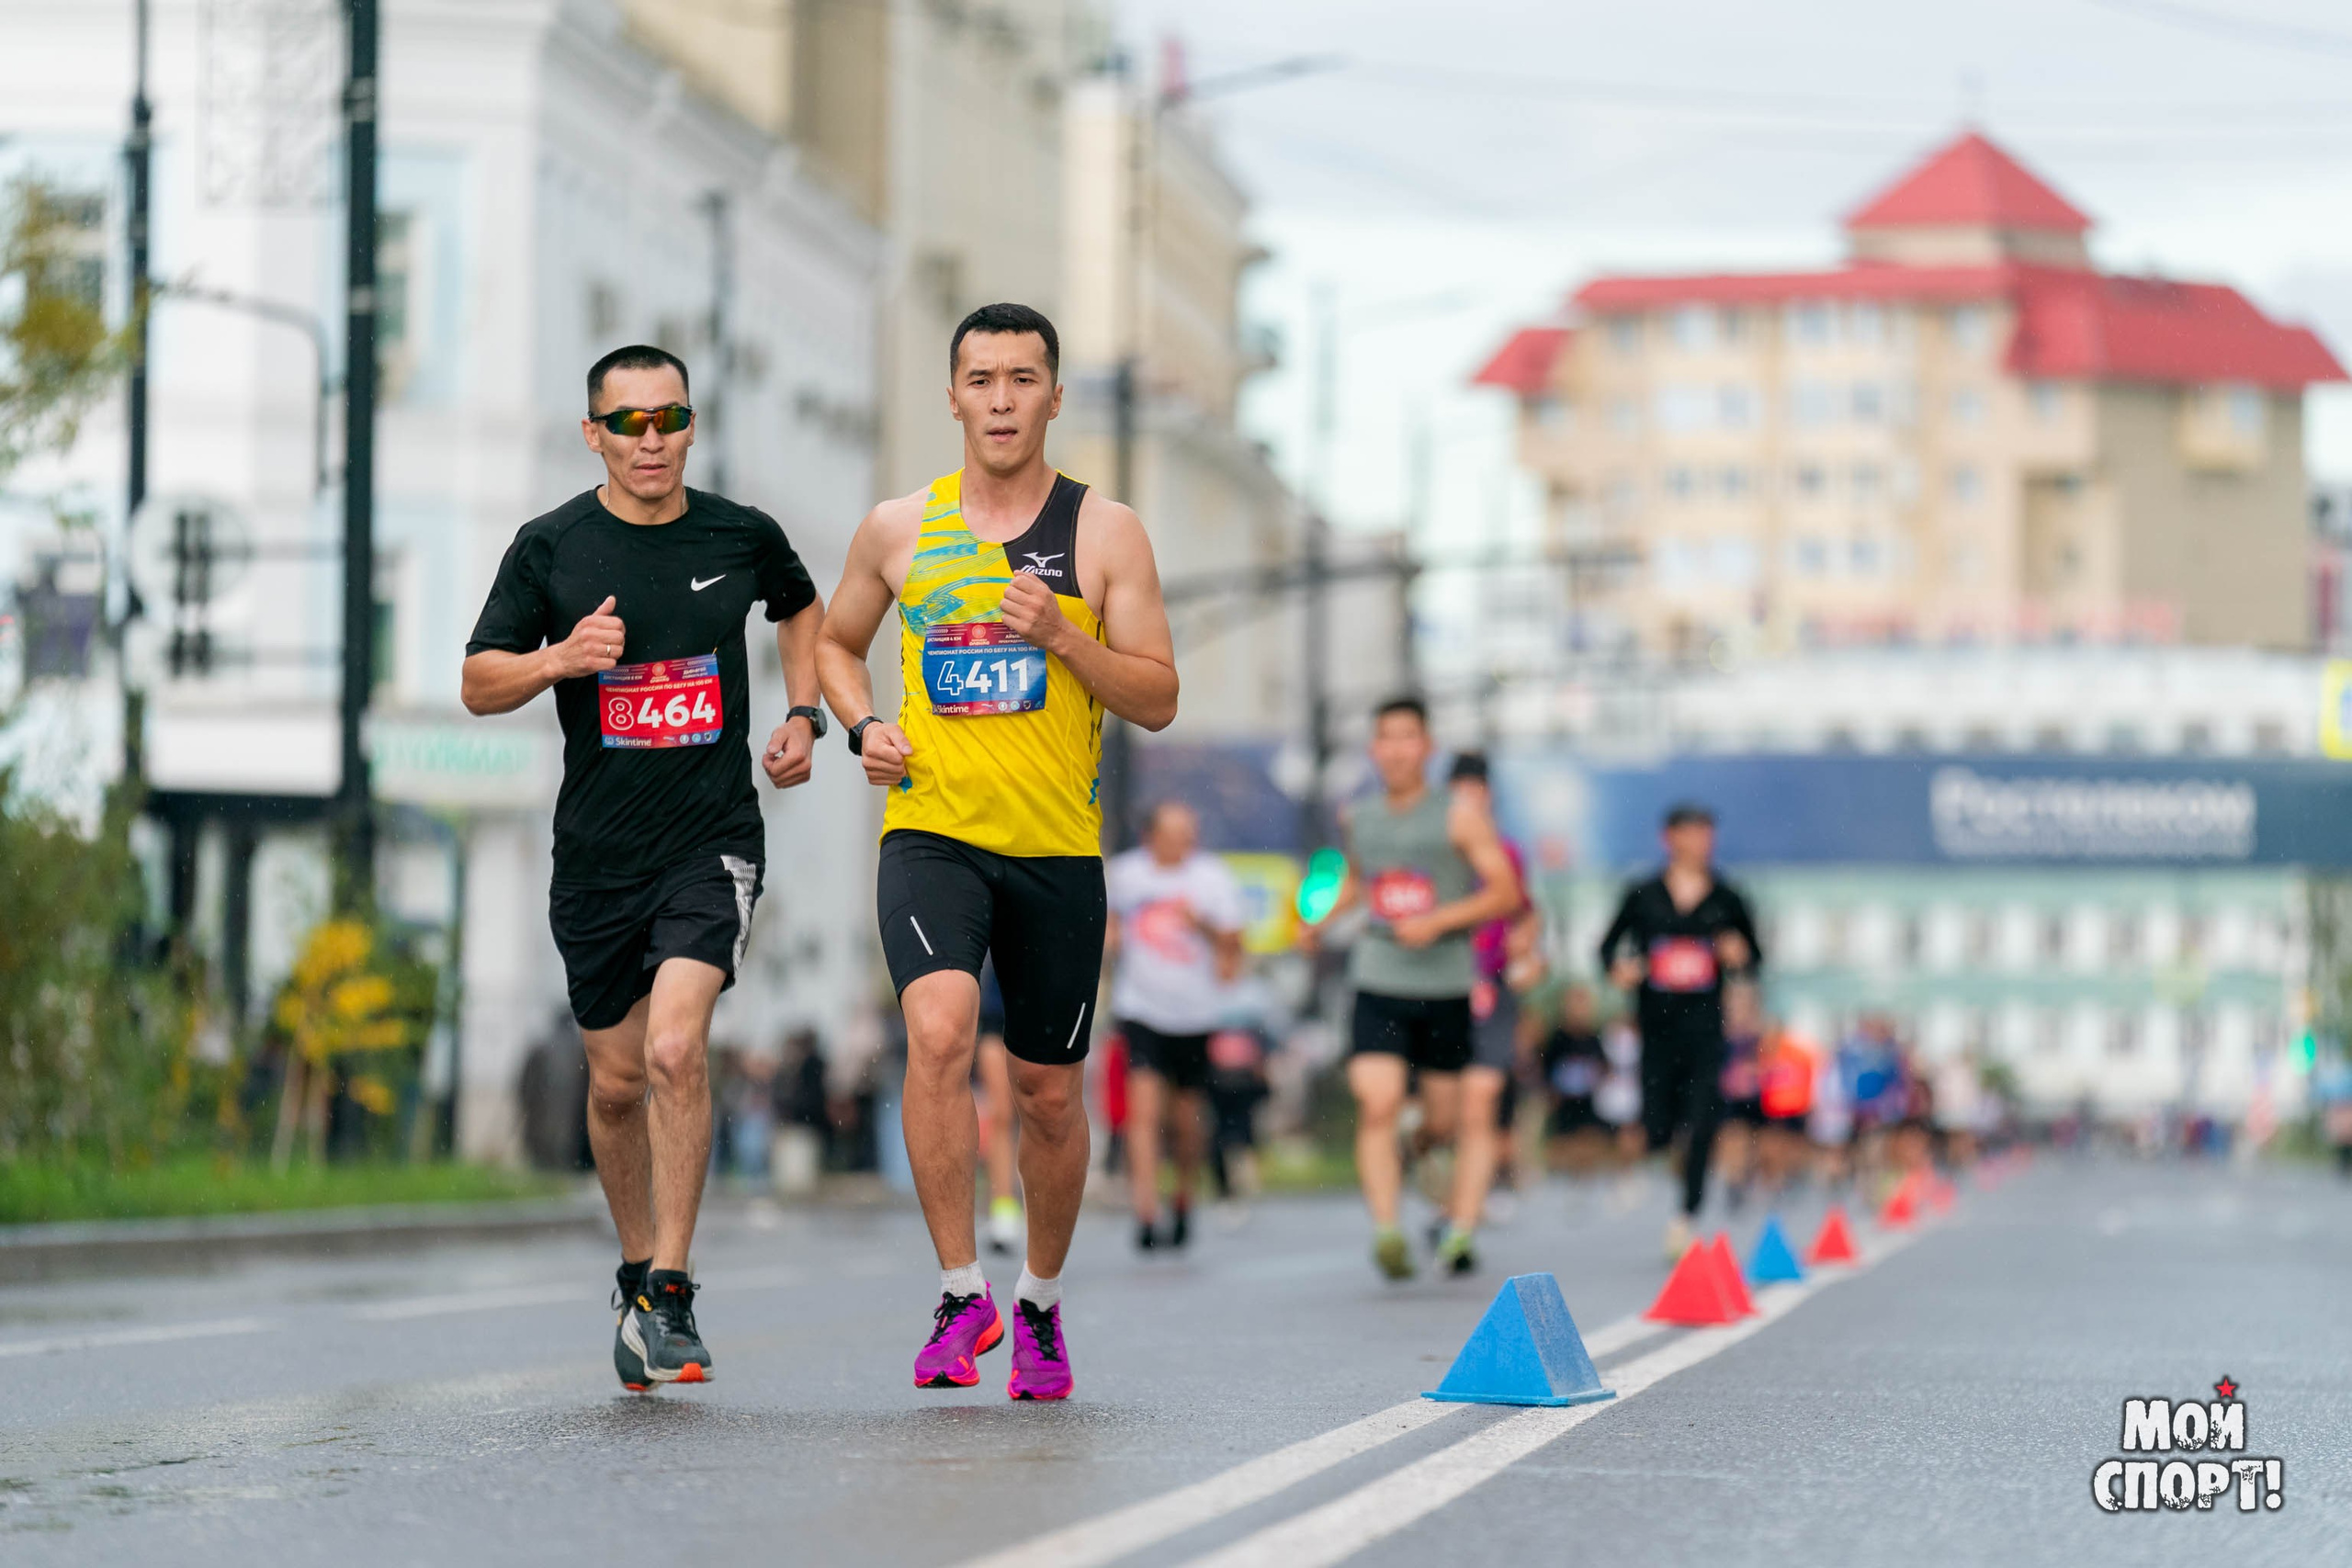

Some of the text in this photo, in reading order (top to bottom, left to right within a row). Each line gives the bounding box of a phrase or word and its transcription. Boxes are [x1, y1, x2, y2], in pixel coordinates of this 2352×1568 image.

[937, 658, 1028, 696] 4411
[608, 691, 716, 730] 8464
[616, 738, 652, 747] Skintime
